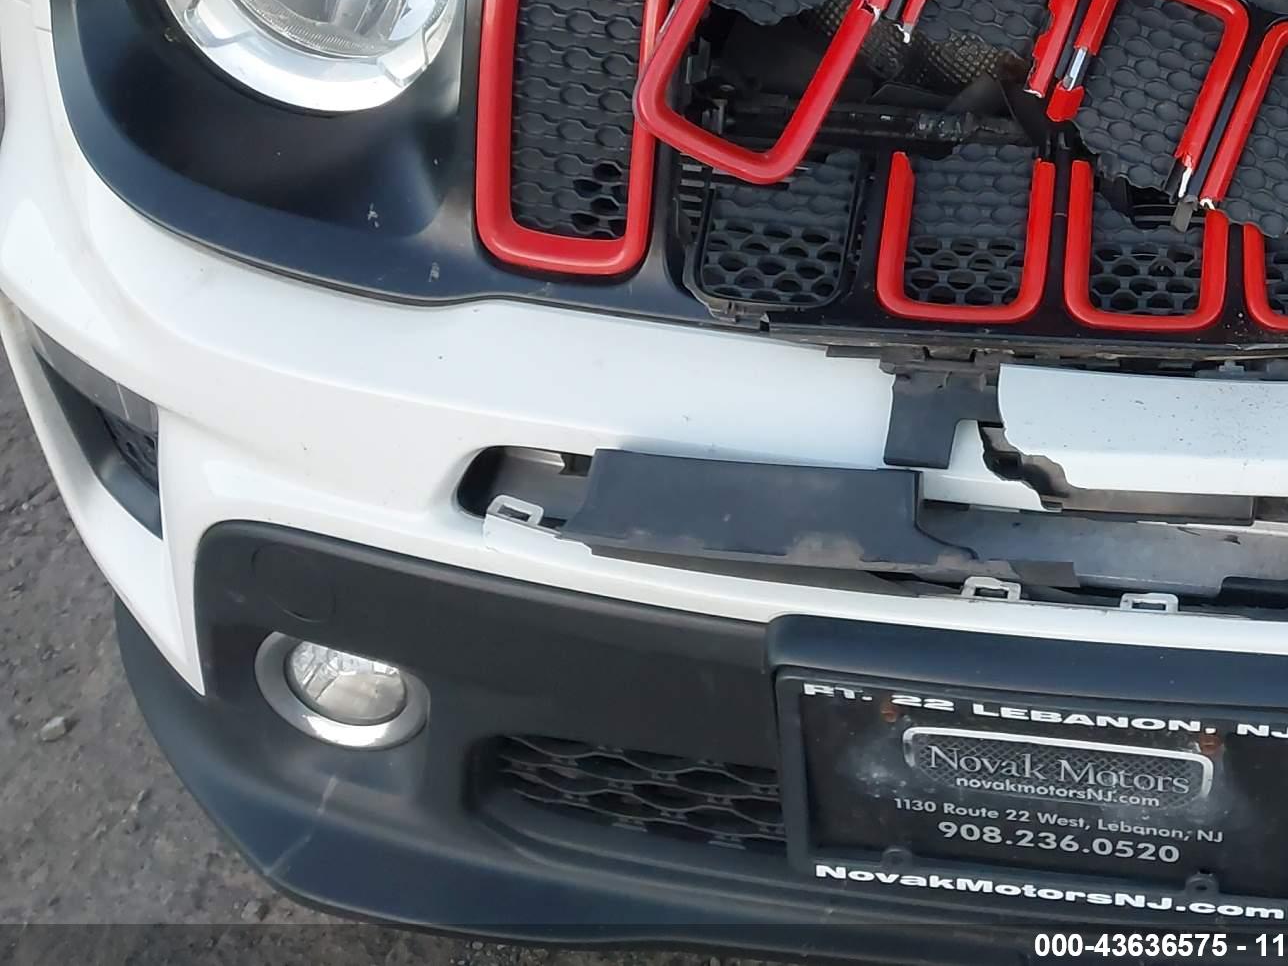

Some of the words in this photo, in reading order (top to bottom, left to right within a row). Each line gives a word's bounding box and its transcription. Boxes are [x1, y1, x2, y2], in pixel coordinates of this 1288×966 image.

[891, 694, 955, 711] 22
[972, 703, 1217, 734] LEBANON,
[928, 745, 1046, 782] Novak
[1057, 758, 1190, 795] Motors
[955, 776, 1160, 807] novakmotorsNJ.com
[895, 798, 937, 814] 1130
[943, 803, 999, 820] Route
[1005, 809, 1031, 823] 22
[1036, 812, 1092, 831] West,
[1097, 819, 1192, 841] Lebanon,
[1197, 830, 1224, 844] NJ
[938, 821, 1181, 863] 908.236.0520
[815, 865, 1285, 920] NovakMotorsNJ.com
